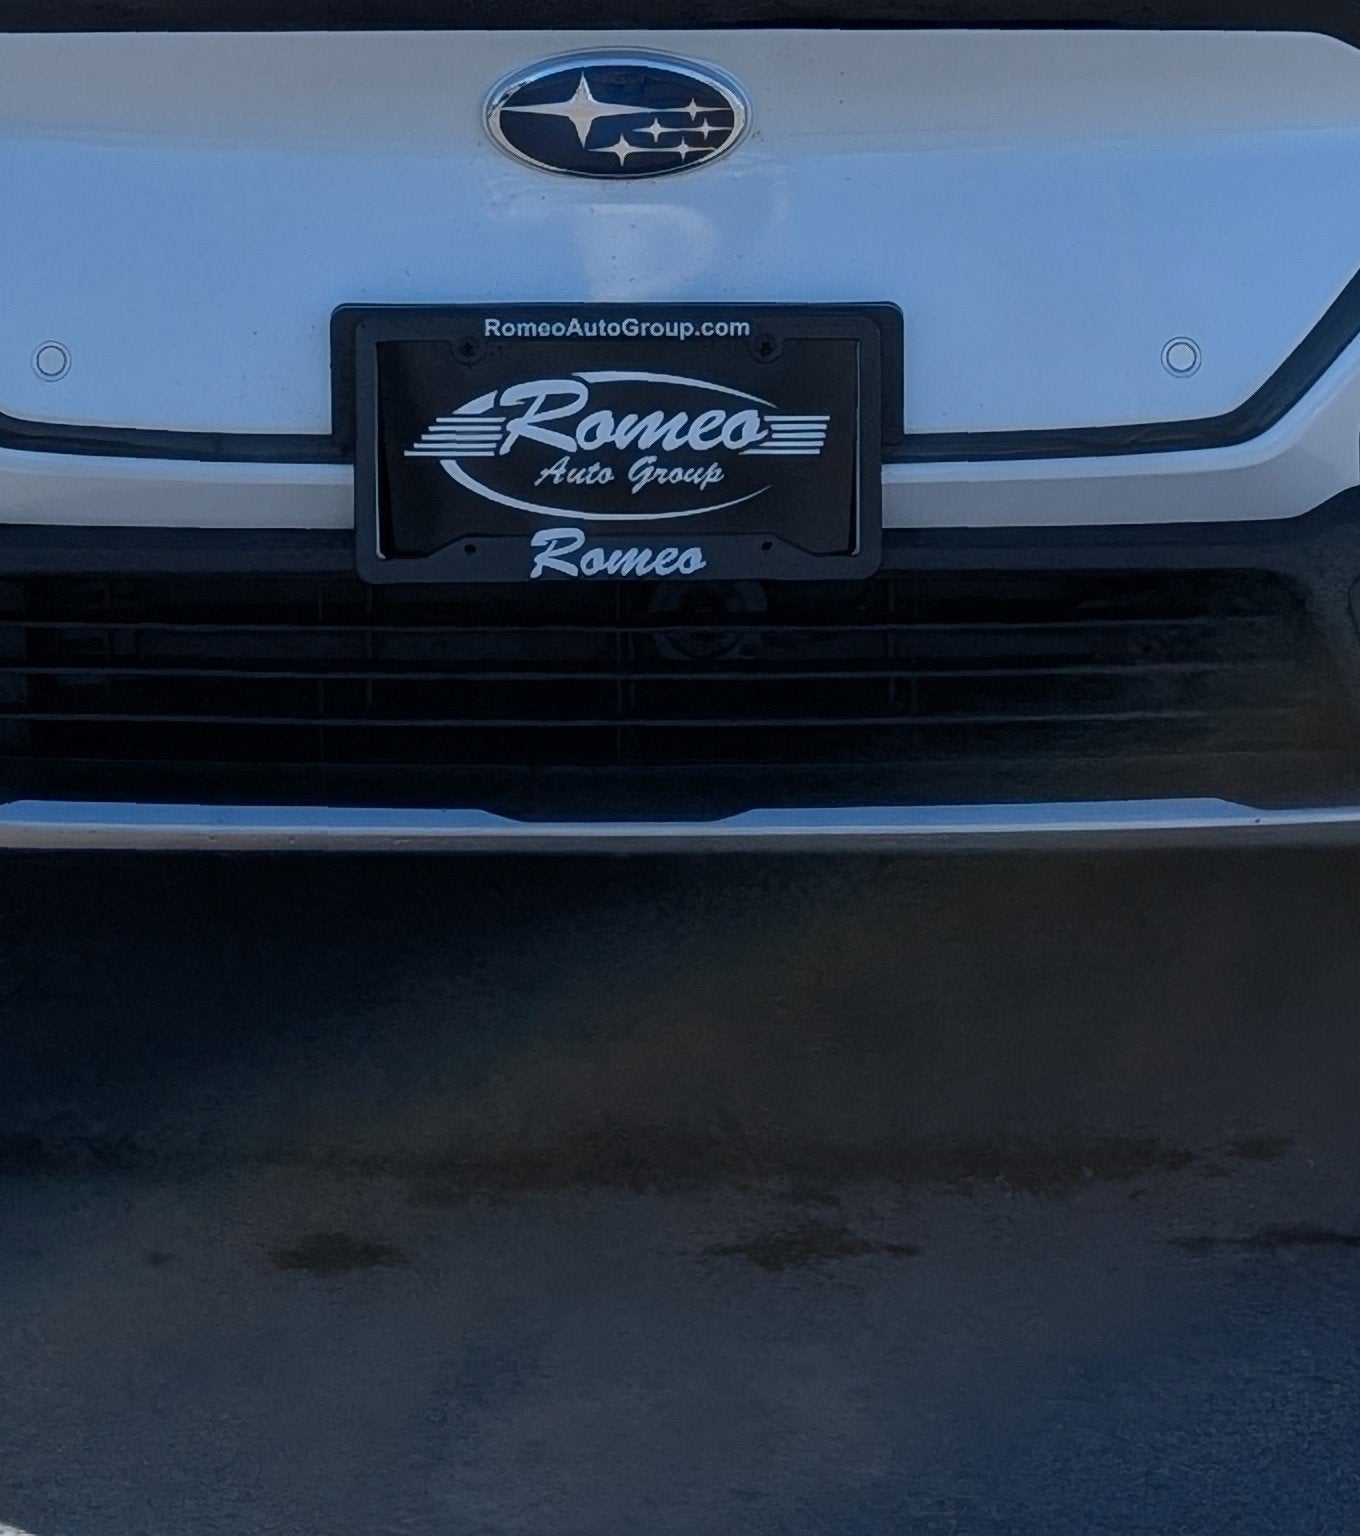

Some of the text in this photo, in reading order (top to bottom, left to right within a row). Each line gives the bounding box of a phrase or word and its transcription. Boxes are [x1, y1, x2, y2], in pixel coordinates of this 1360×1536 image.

[483, 317, 751, 341] RomeoAutoGroup.com
[498, 378, 771, 456] Romeo
[533, 455, 725, 494] Auto Group
[529, 527, 708, 580] Romeo
